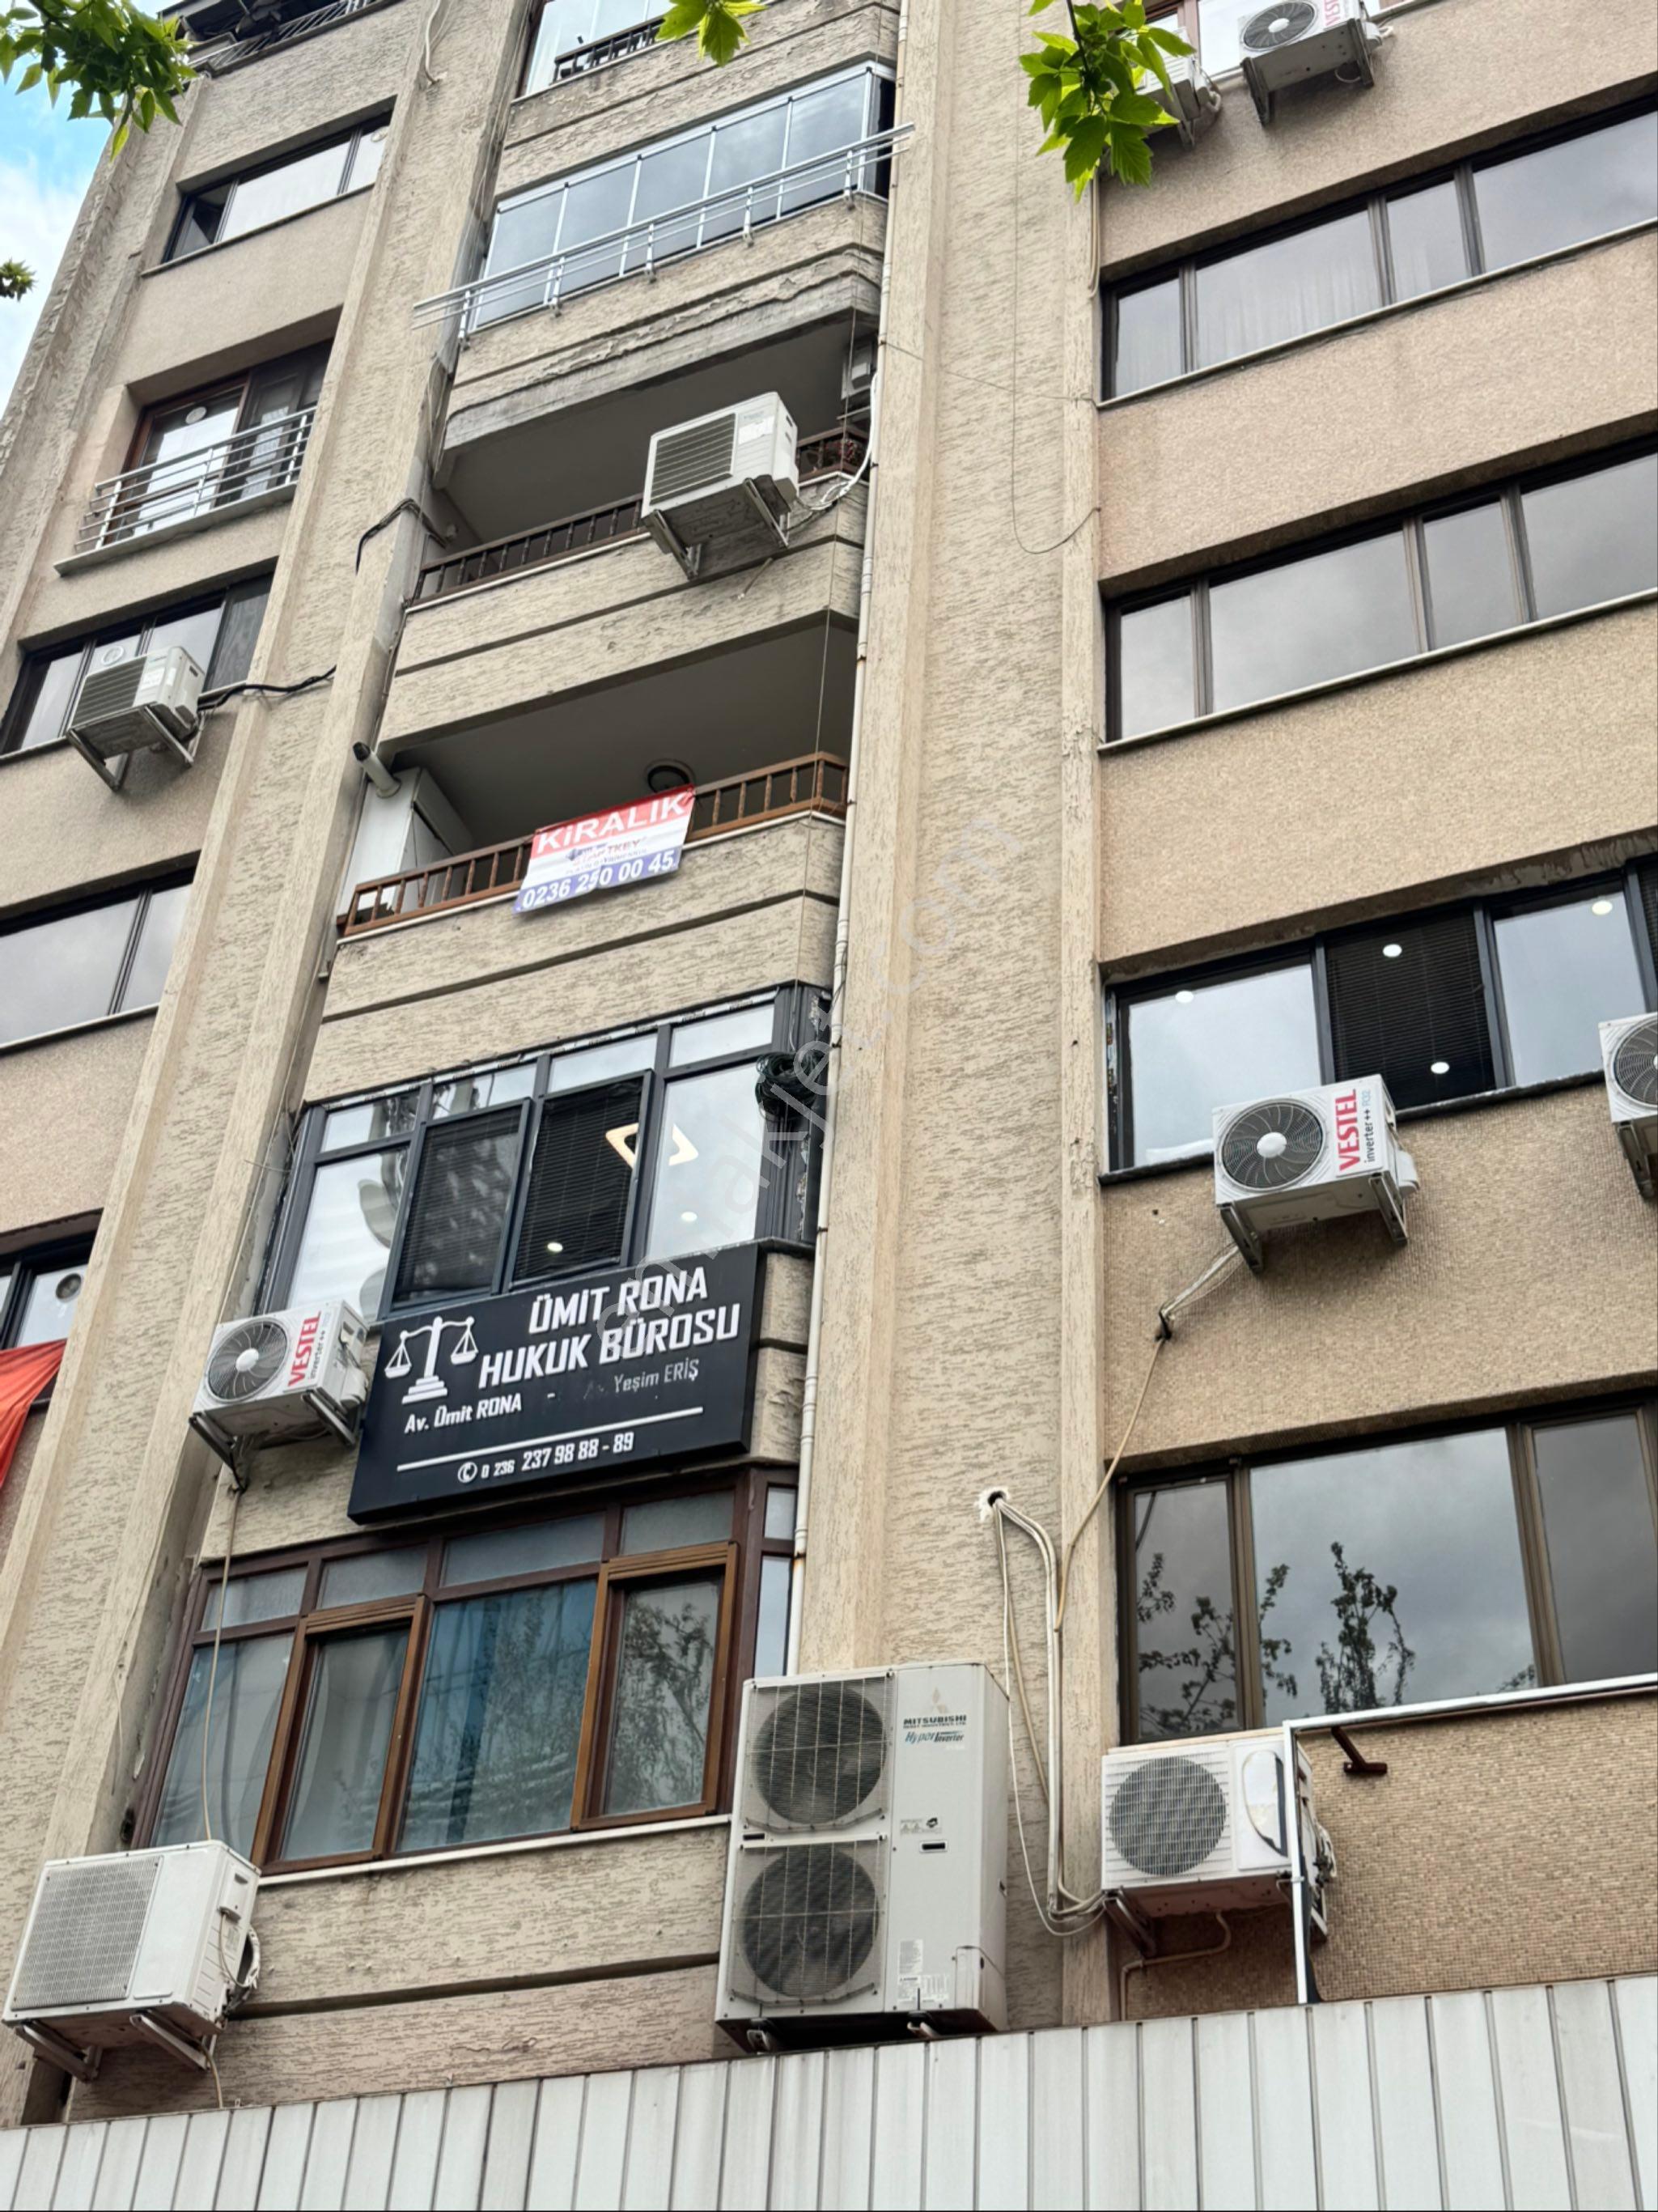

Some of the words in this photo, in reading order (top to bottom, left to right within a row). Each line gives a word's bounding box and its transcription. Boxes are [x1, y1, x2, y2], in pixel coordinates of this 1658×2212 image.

[523, 878, 571, 908] 0236
[618, 858, 643, 881] 00
[648, 850, 675, 873] 45
[1335, 1089, 1361, 1171] VESTEL
[528, 1286, 610, 1334] ÜMİT
[617, 1267, 708, 1317] RONA
[288, 1311, 321, 1386] VESTEL
[478, 1334, 592, 1389] HUKUK
[599, 1303, 740, 1365] BÜROSU
[405, 1414, 430, 1433] Av.
[476, 1393, 522, 1420] RONA
[614, 1371, 659, 1393] Yeşim
[664, 1357, 699, 1382] ERİŞ
[493, 1459, 516, 1477] 236
[521, 1447, 552, 1471] 237
[554, 1443, 575, 1464] 98
[578, 1437, 600, 1460] 88
[613, 1431, 634, 1454] 89
[903, 1714, 967, 1725] MITSUBISHI
